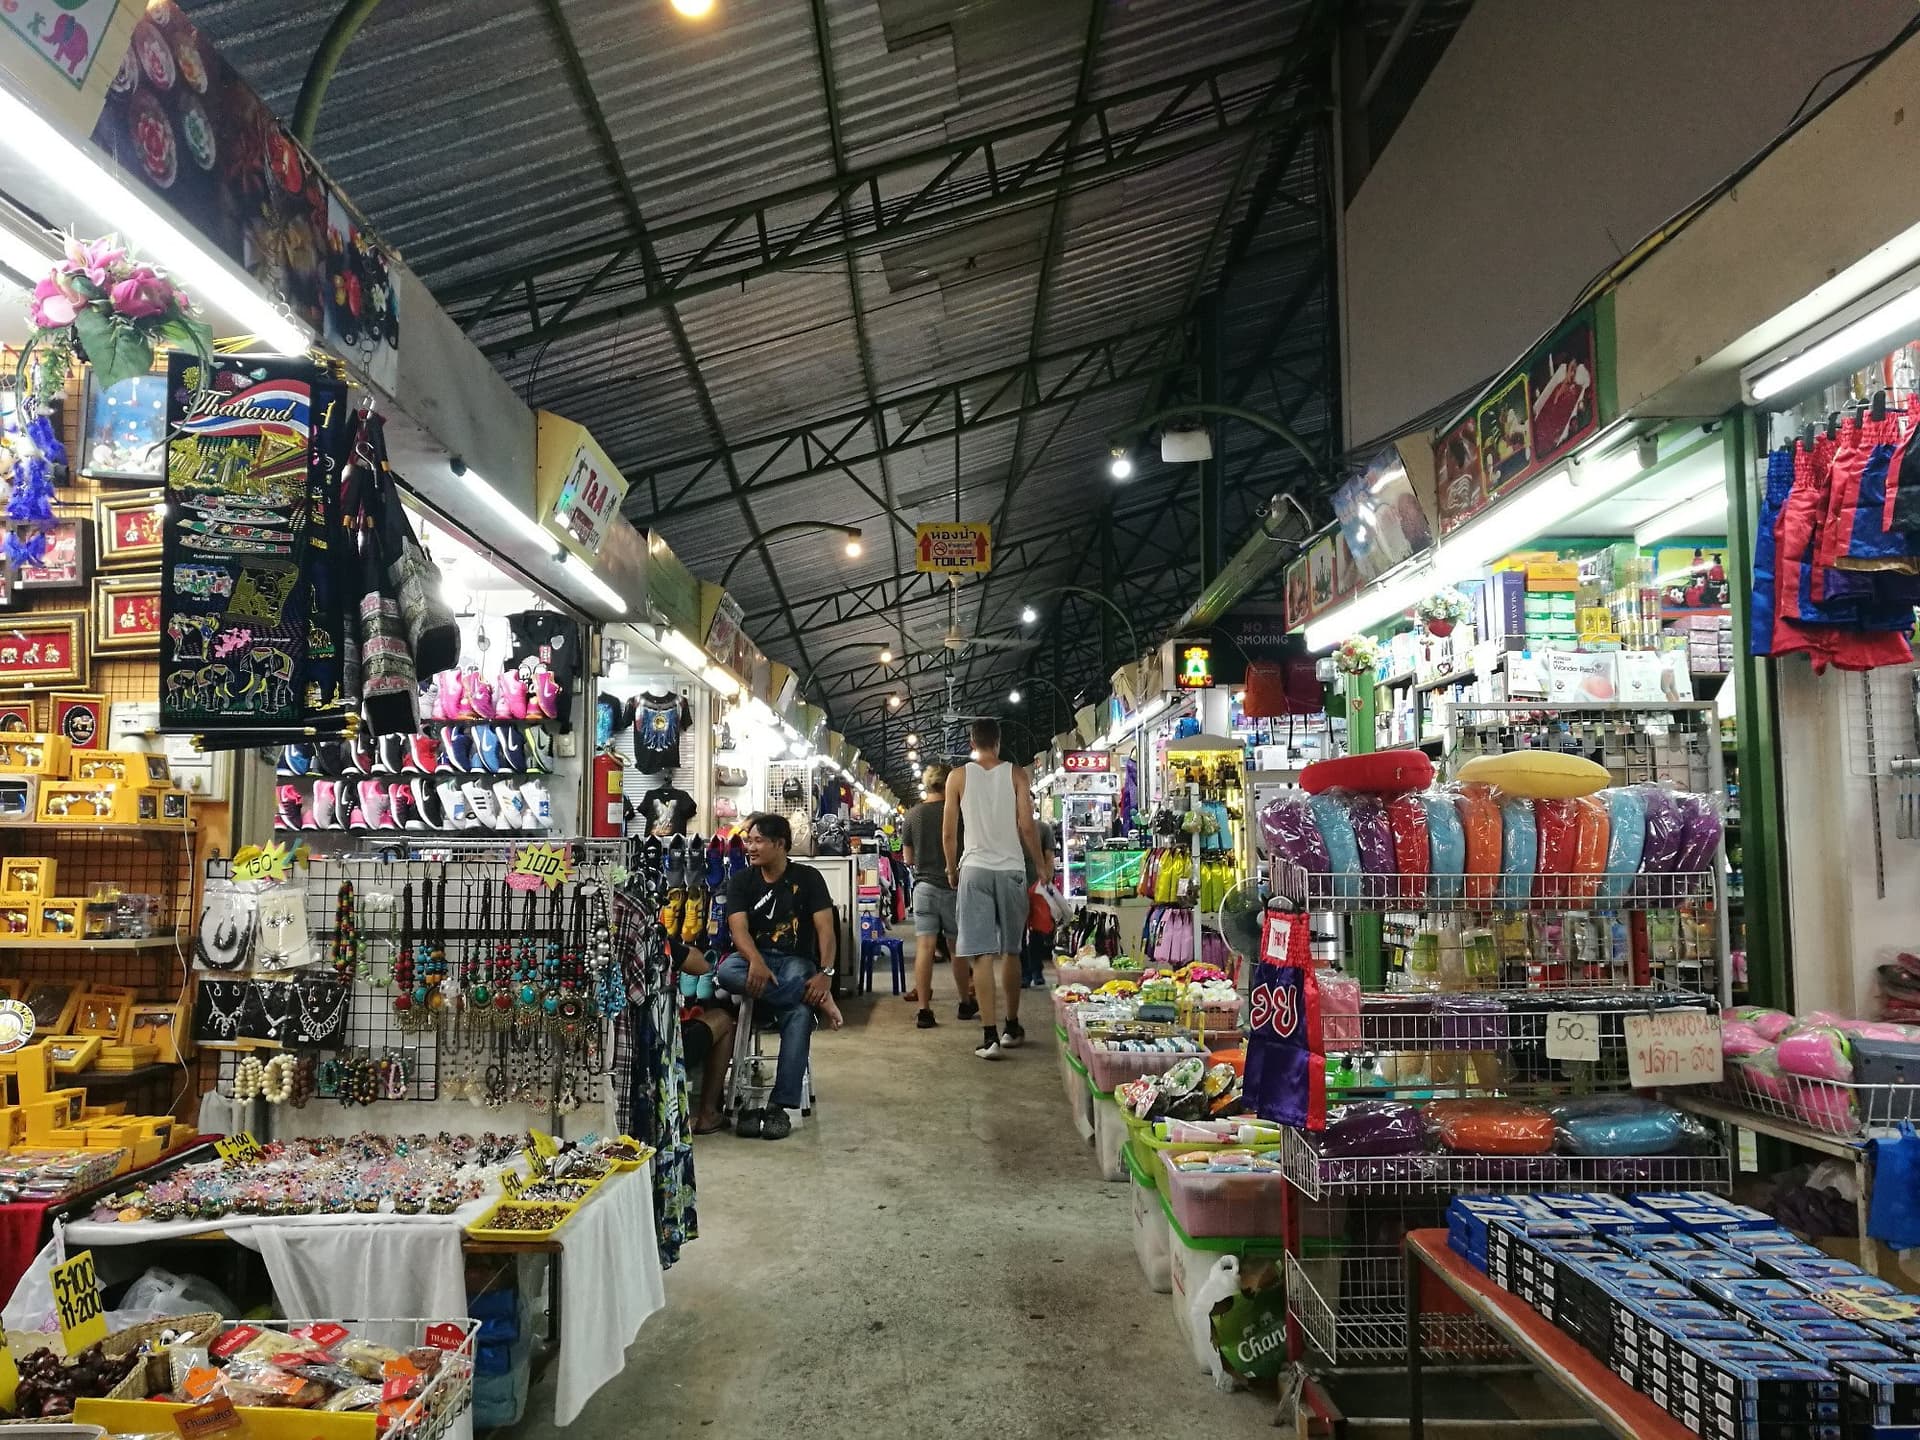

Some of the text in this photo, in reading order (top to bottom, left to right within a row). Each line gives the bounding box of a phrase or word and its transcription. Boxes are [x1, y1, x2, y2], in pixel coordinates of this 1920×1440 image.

[183, 389, 297, 421] Thailand
[930, 525, 977, 540] ห้องน้ำ
[932, 556, 977, 567] TOILET
[1243, 622, 1262, 632] NO
[1236, 634, 1289, 645] SMOKING
[1066, 757, 1108, 767] OPEN
[54, 1257, 96, 1306] 5-100
[62, 1287, 103, 1330] 11-200
